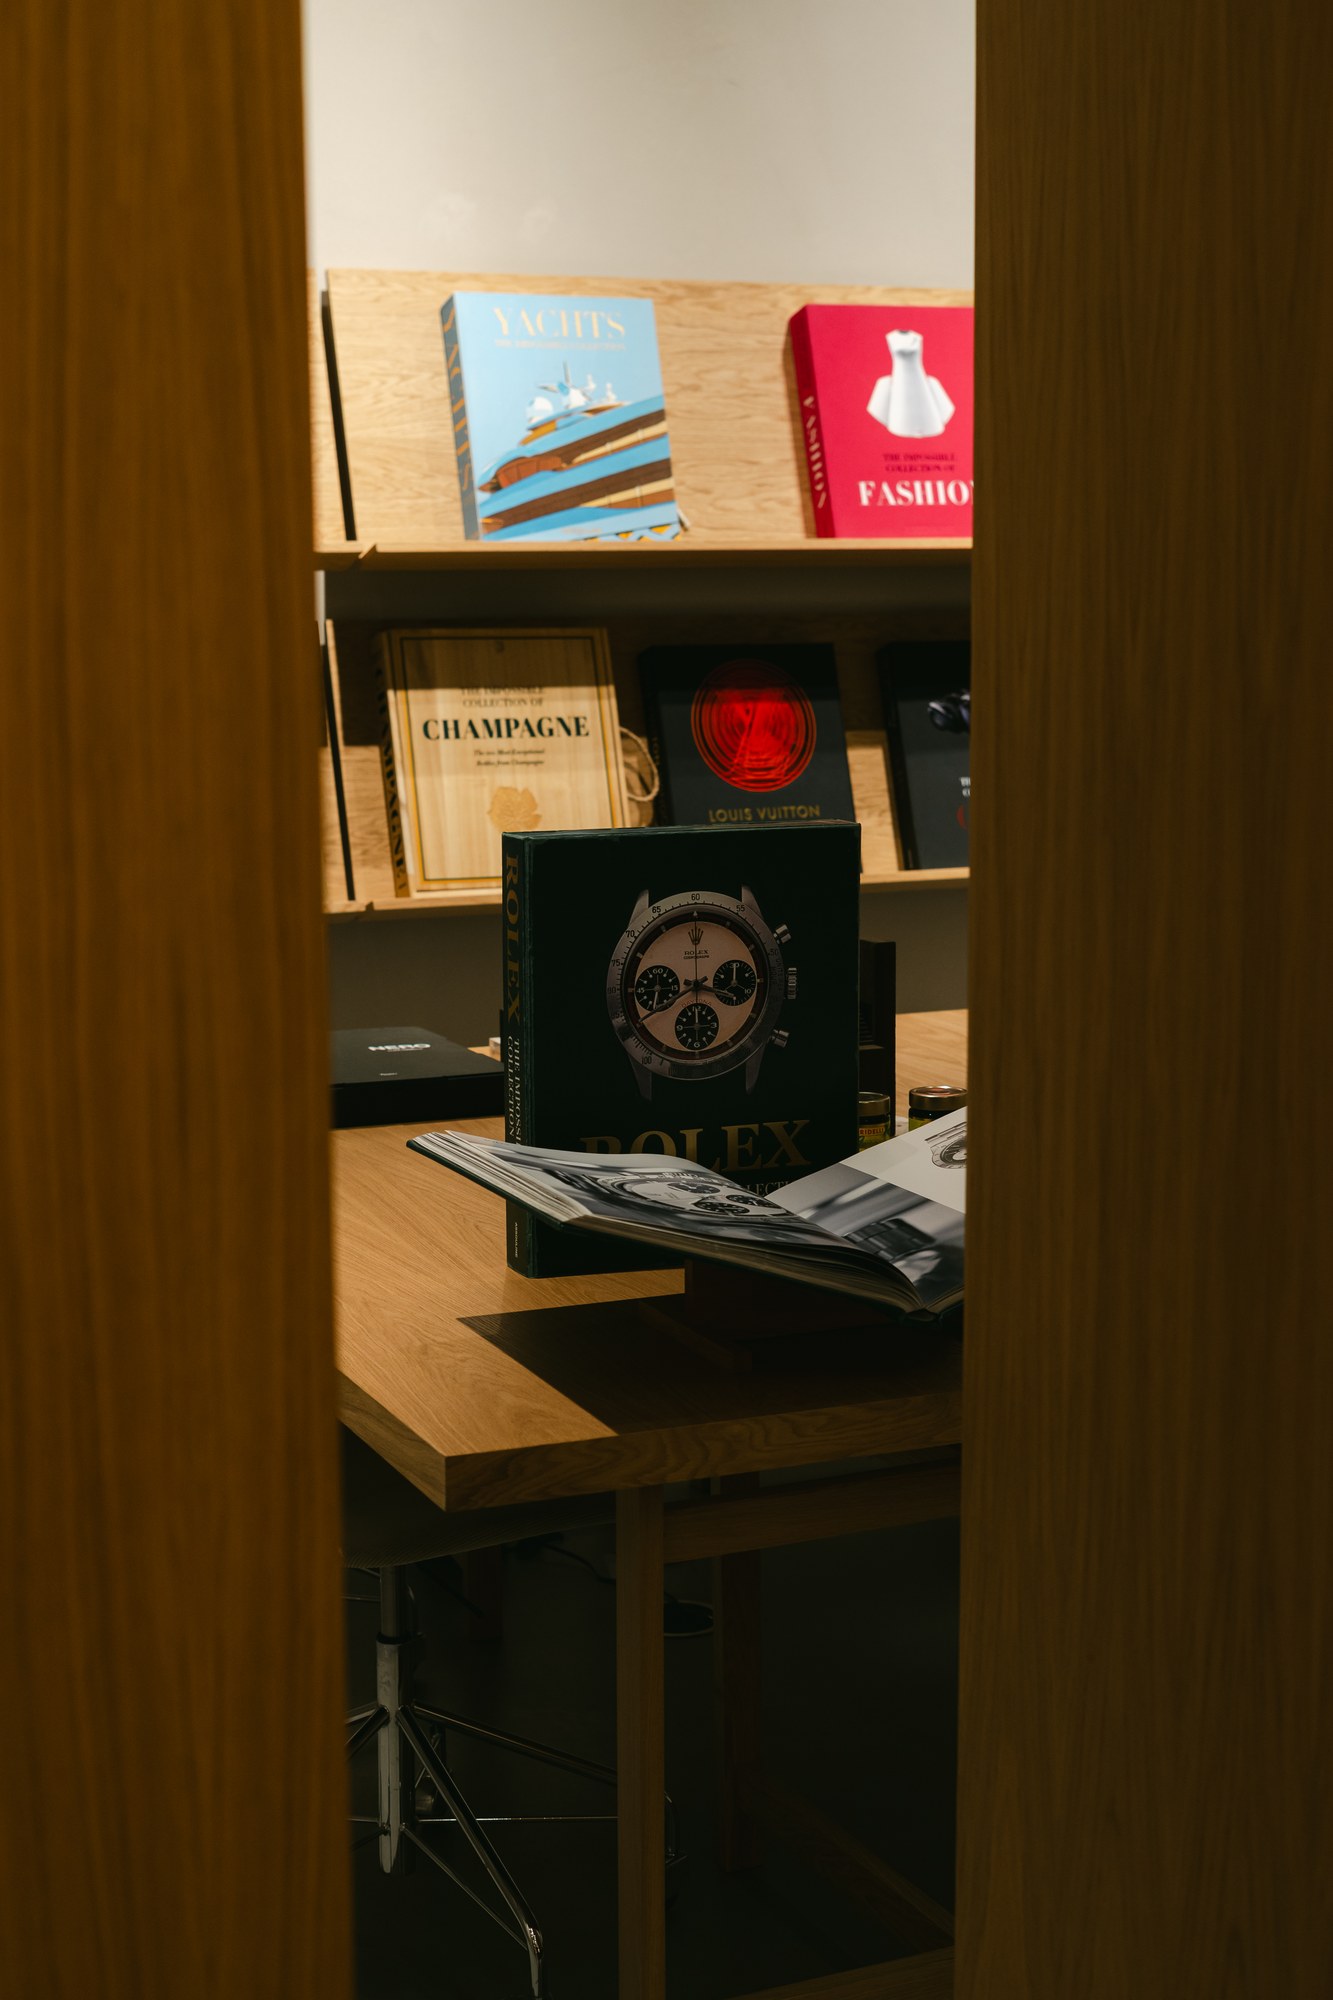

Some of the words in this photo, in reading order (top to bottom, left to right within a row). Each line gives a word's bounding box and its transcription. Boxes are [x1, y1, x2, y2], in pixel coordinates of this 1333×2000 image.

[493, 307, 625, 338] YACHTS
[858, 480, 974, 506] FASHIO
[423, 715, 590, 741] CHAMPAGNE
[708, 807, 753, 823] LOUIS
[757, 805, 820, 820] VUITTON
[506, 855, 521, 1026] ROLEX
[625, 930, 635, 938] 70
[611, 959, 621, 967] 75
[507, 1035, 515, 1137] COLLECTION
